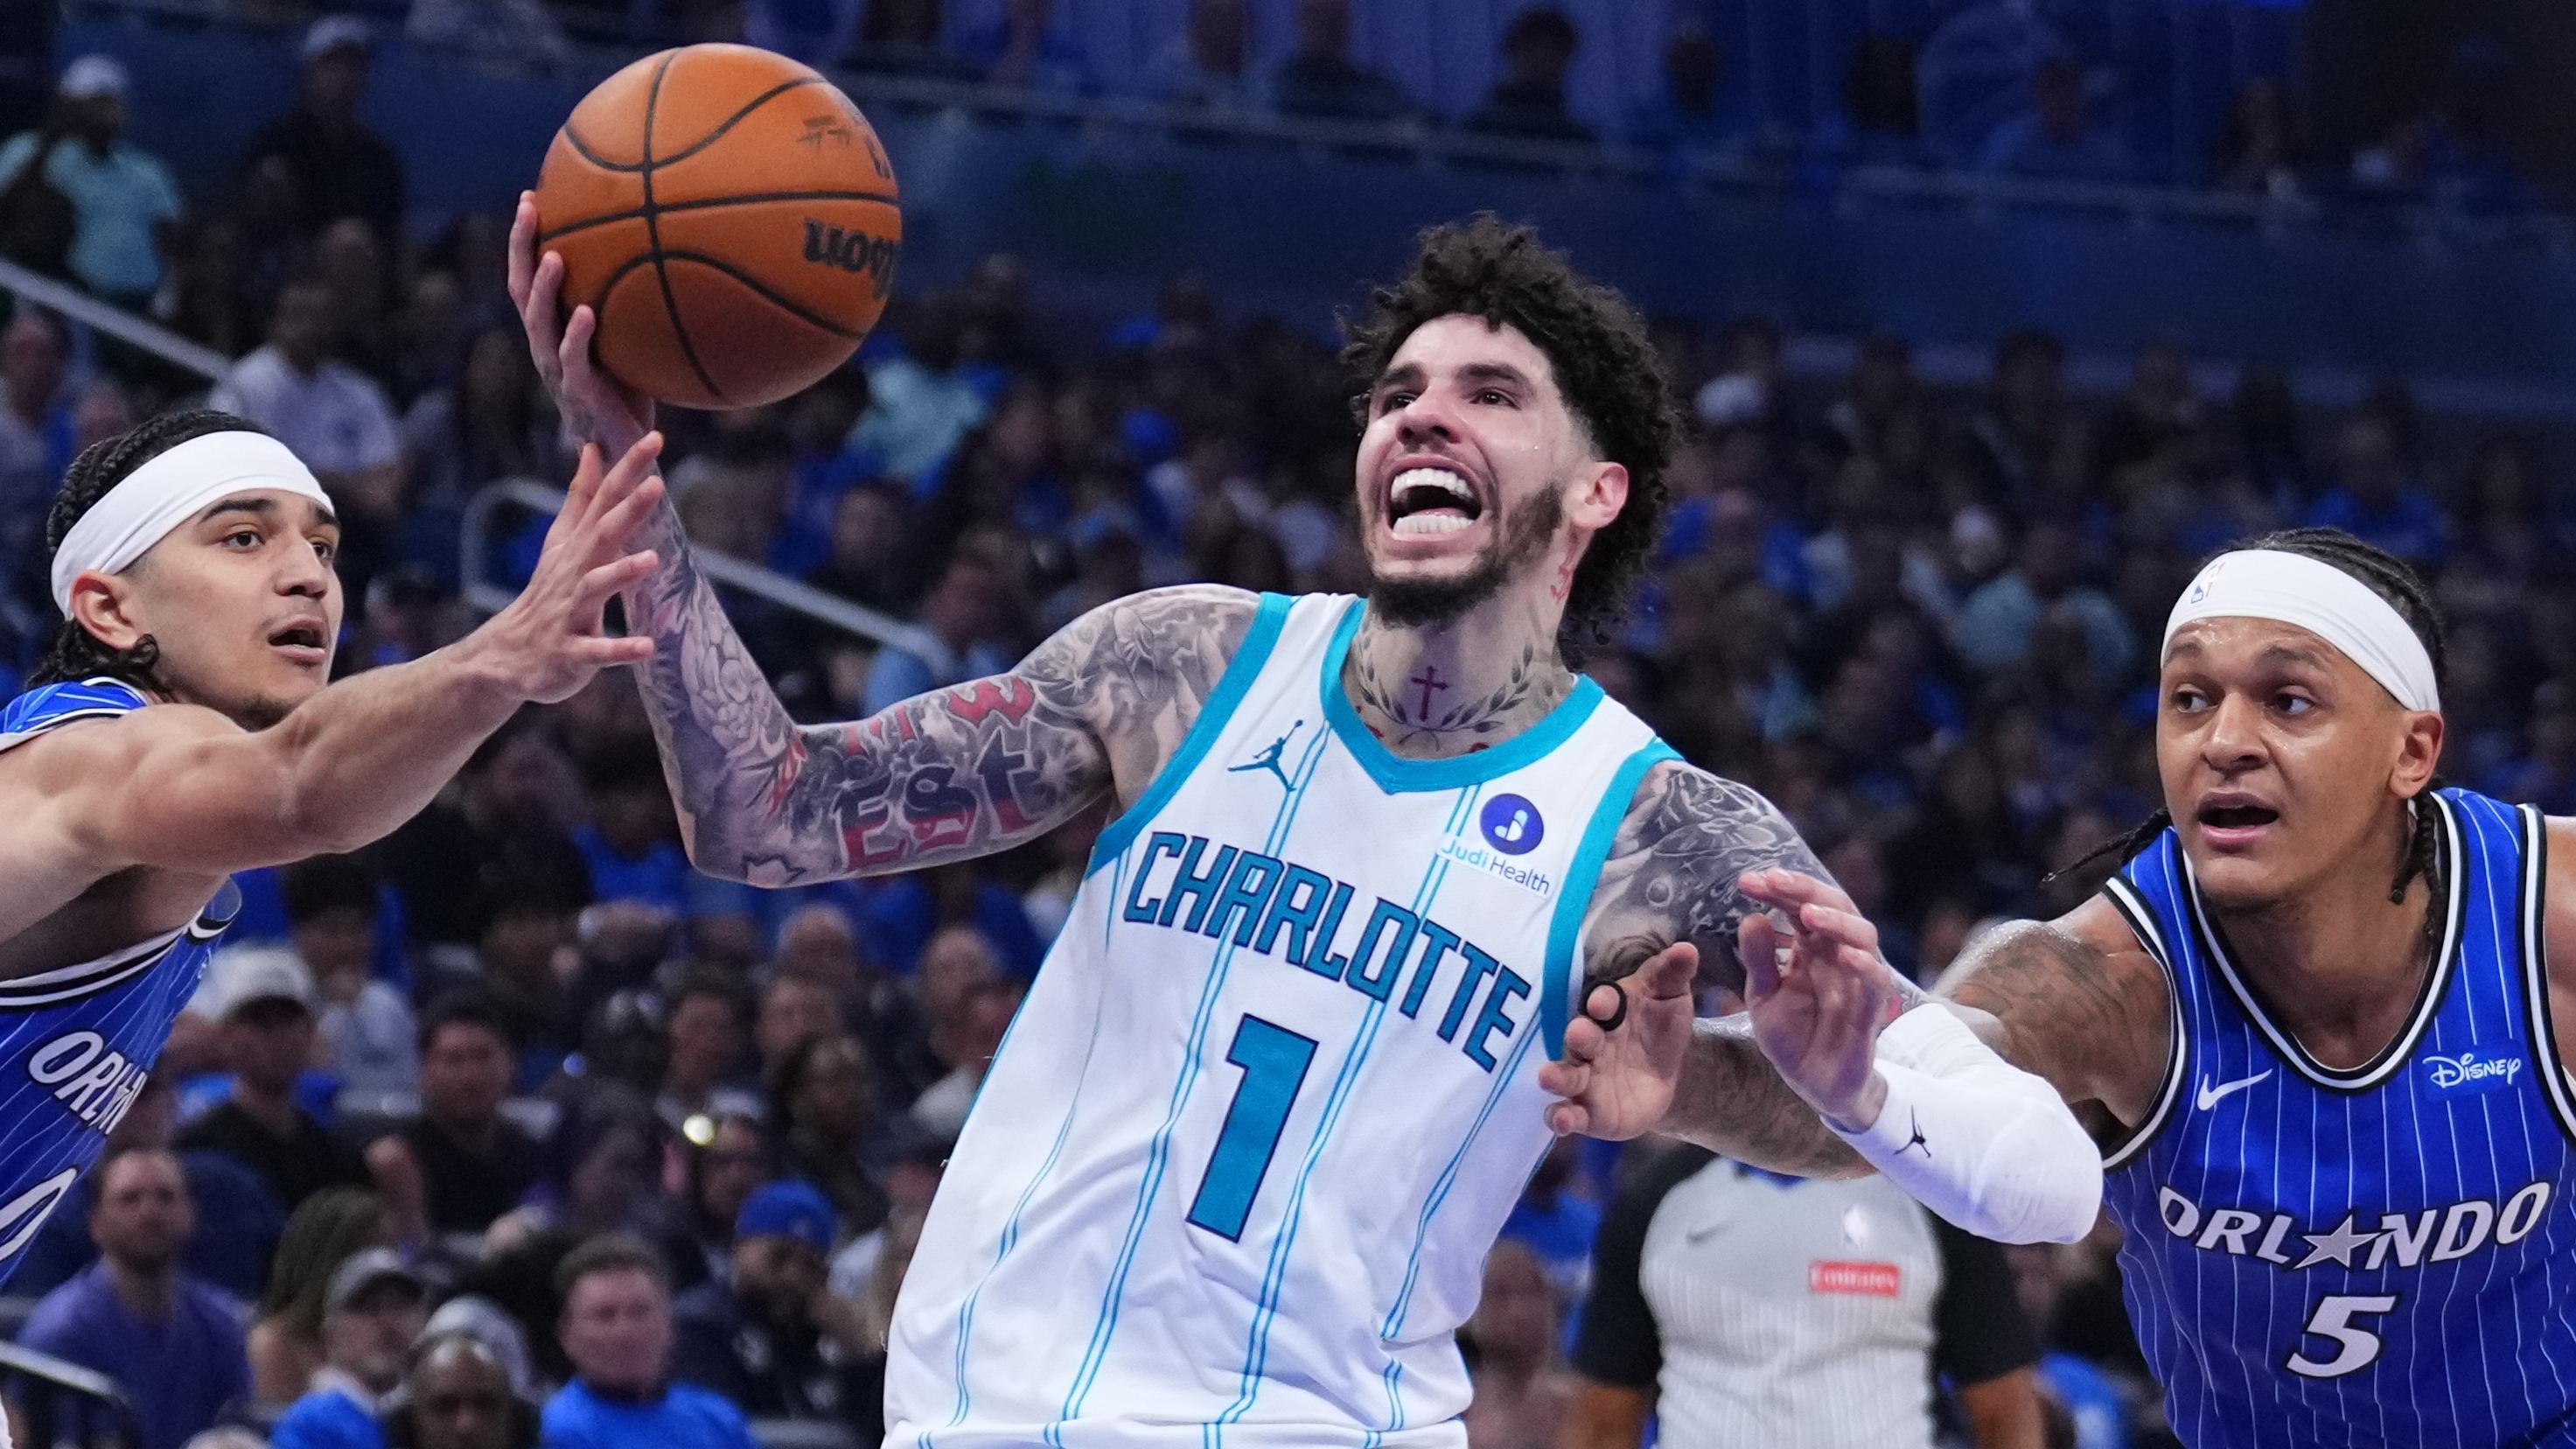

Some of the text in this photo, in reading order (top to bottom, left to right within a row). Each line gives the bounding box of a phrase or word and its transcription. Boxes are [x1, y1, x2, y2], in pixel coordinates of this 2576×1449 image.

[1441, 837, 1551, 896] Judi Health
[1122, 830, 1532, 1074] CHARLOTTE
[2421, 1052, 2523, 1089] Disney
[1185, 1012, 1320, 1244] 1
[2285, 1295, 2398, 1378] 5
